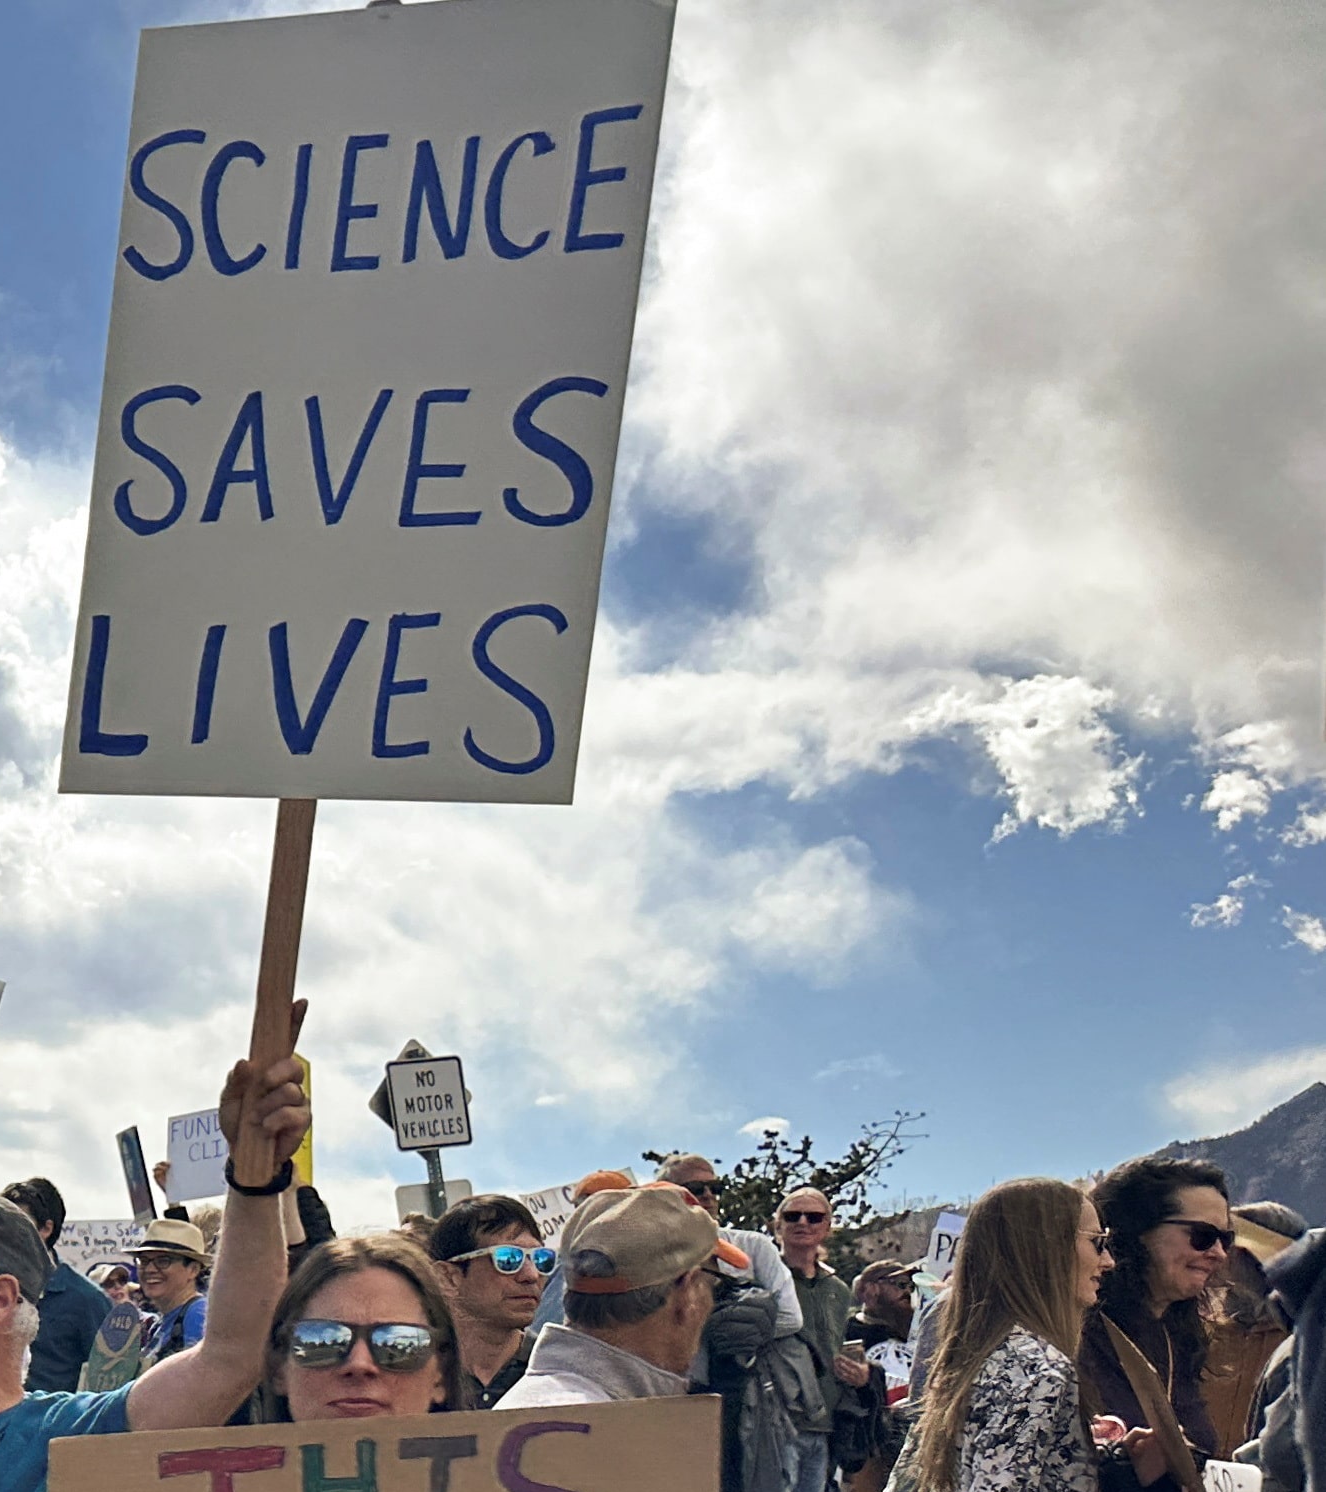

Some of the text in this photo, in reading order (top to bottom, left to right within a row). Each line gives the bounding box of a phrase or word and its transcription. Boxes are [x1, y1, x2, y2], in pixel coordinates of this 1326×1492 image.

[121, 104, 644, 282] SCIENCE
[112, 376, 610, 537] SAVES
[78, 603, 570, 775] LIVES
[405, 1094, 454, 1113] MOTOR
[415, 1070, 435, 1087] NO
[402, 1117, 464, 1138] VEHICLES
